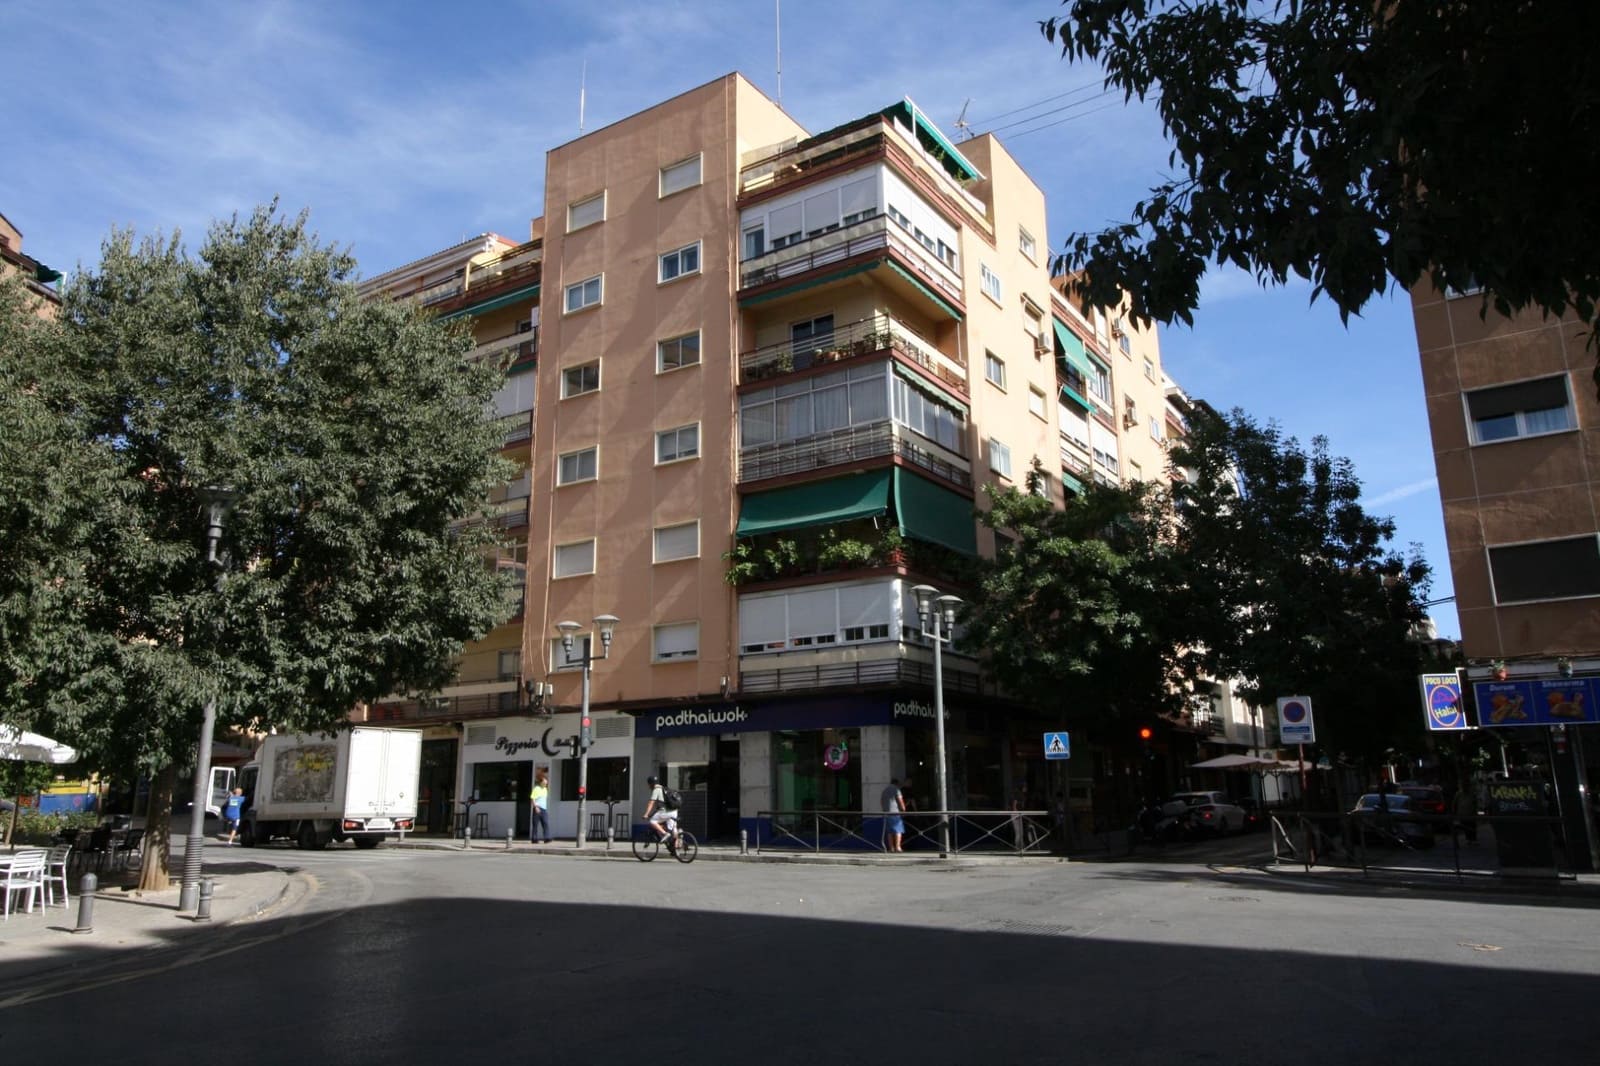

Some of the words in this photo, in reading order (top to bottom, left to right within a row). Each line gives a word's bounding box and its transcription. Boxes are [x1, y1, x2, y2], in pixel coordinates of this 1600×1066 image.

[1442, 676, 1457, 684] LOCO
[656, 706, 745, 731] padthaiwok
[1434, 706, 1457, 719] Halal
[495, 736, 540, 756] Pizzeria
